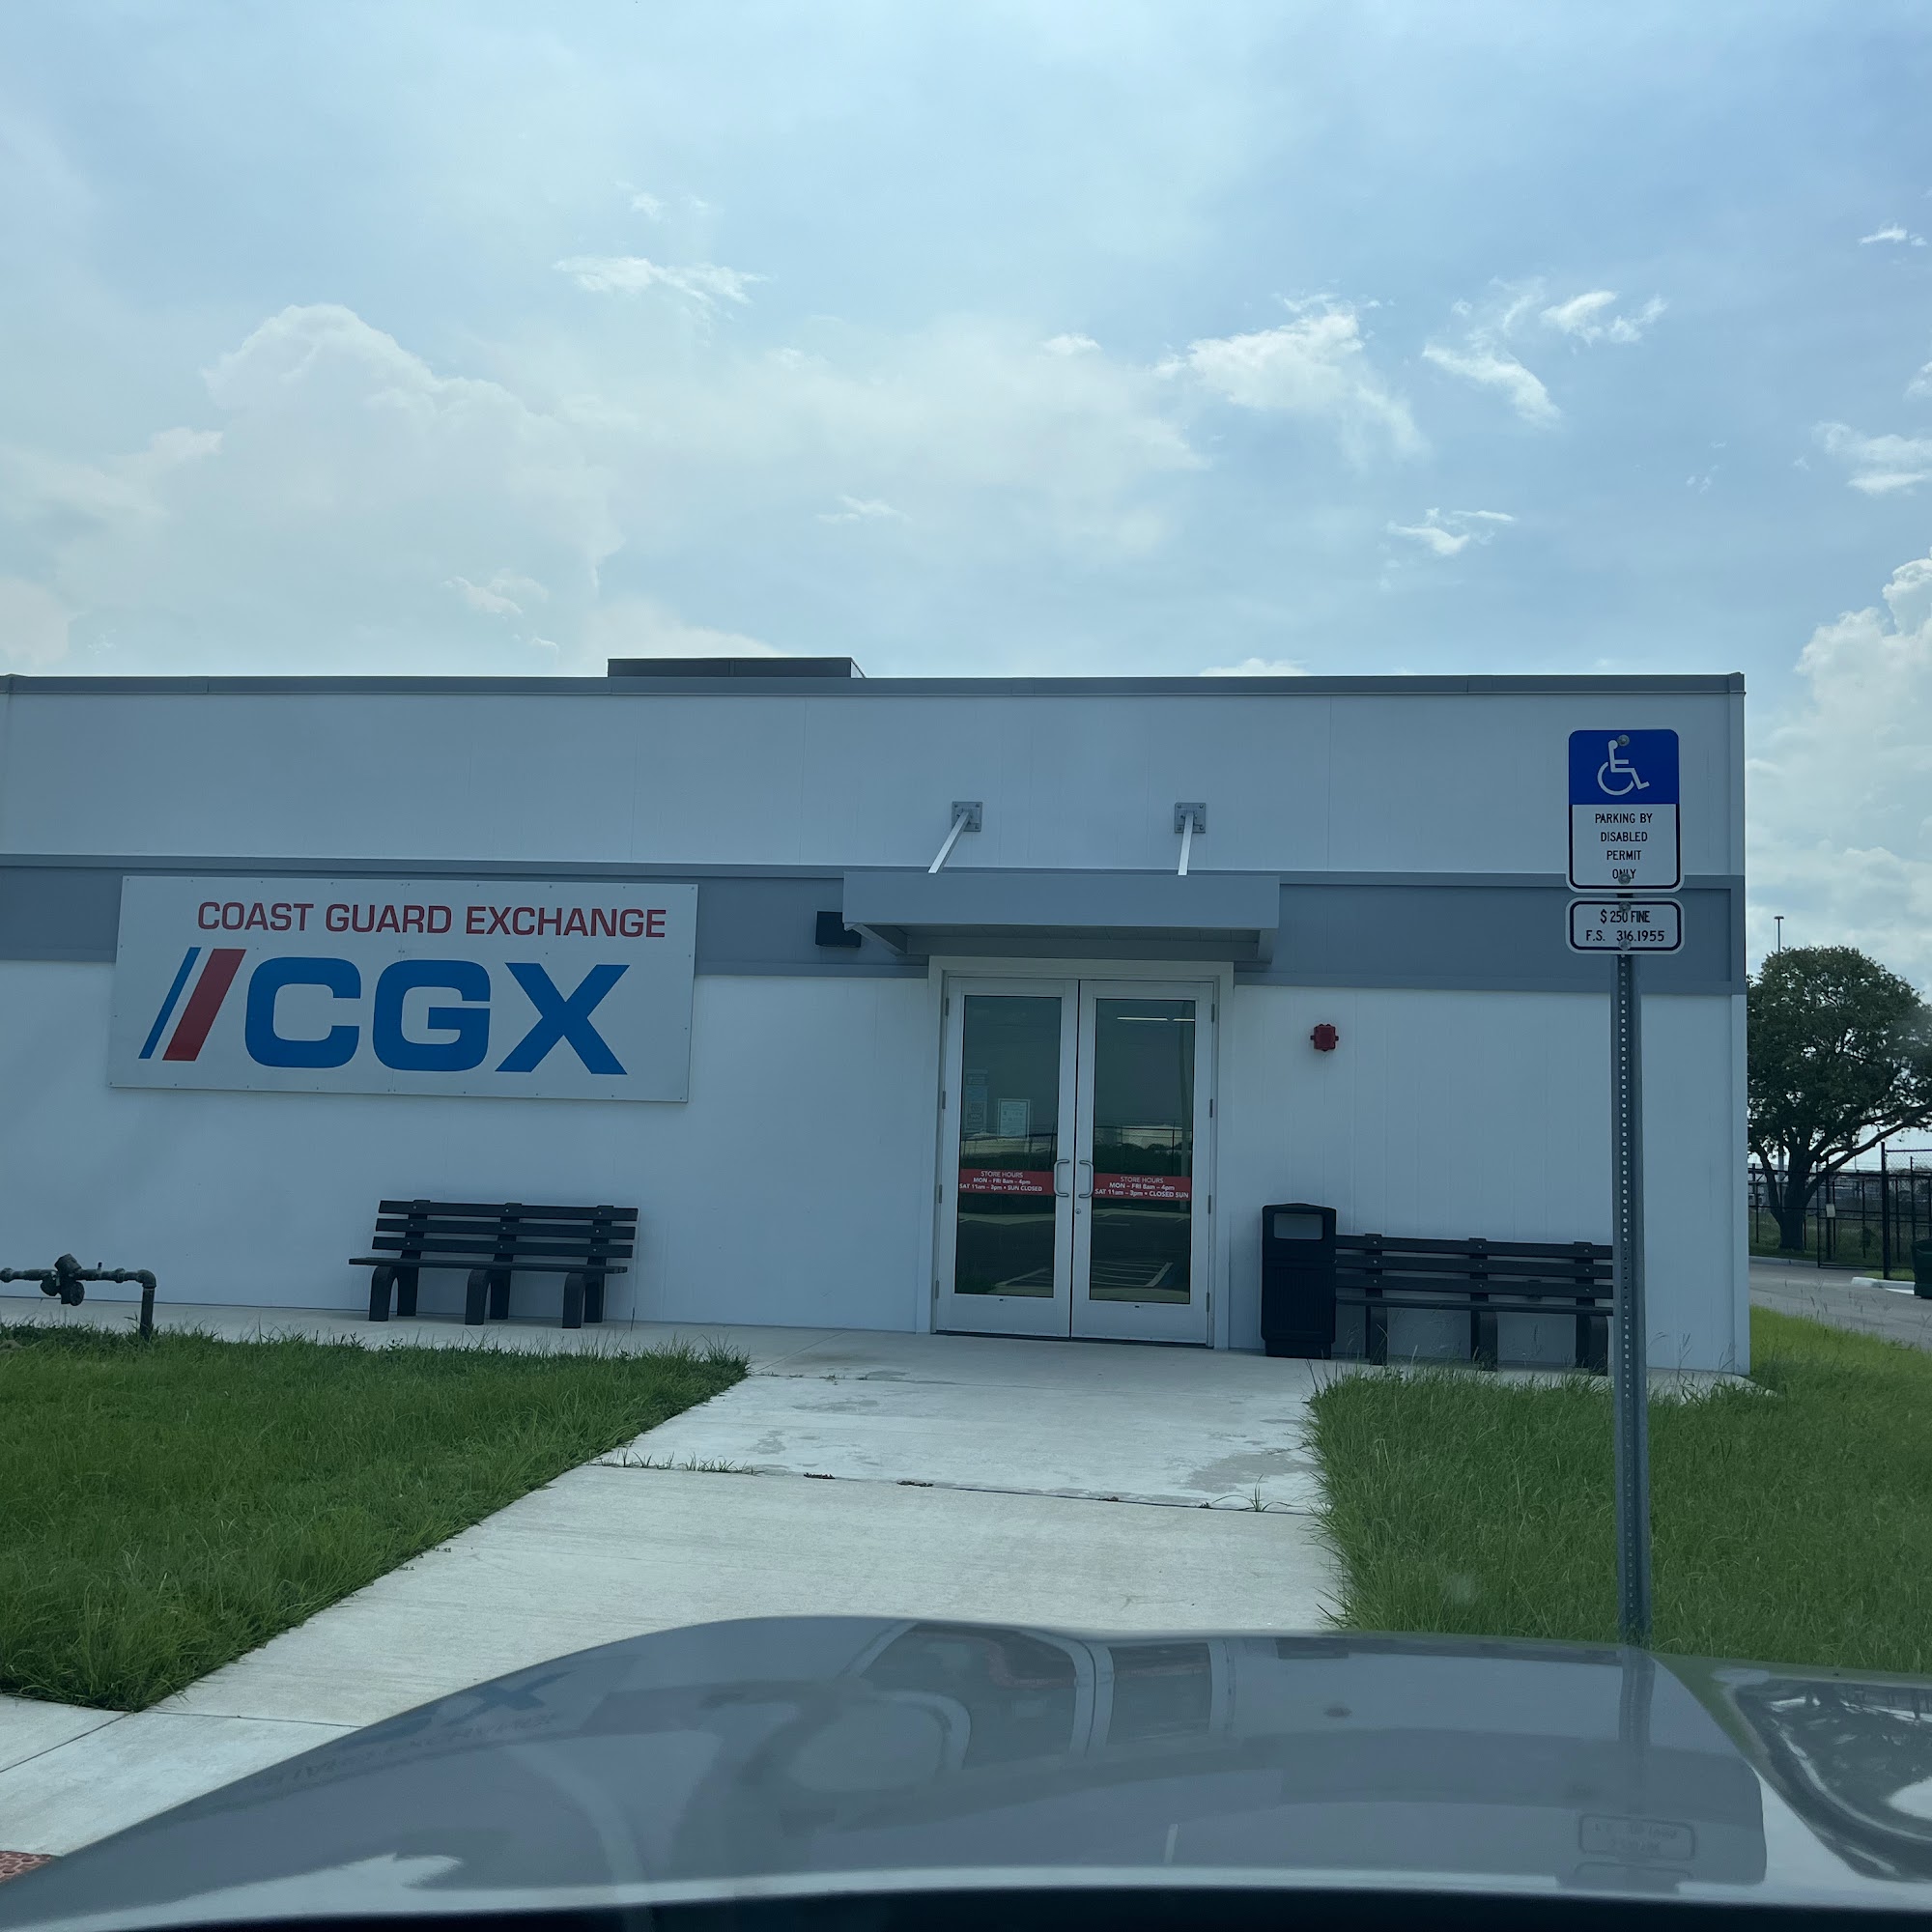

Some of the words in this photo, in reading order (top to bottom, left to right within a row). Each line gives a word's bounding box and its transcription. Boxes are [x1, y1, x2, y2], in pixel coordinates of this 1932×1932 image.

[1595, 813, 1635, 824] PARKING
[1640, 813, 1653, 824] BY
[1601, 832, 1648, 842] DISABLED
[1606, 850, 1642, 860] PERMIT
[197, 901, 313, 931] COAST
[325, 903, 453, 934] GUARD
[465, 906, 668, 938] EXCHANGE
[1631, 910, 1650, 923] FINE
[1586, 930, 1605, 941] F.S.
[1616, 930, 1665, 941] 316.1955
[244, 956, 631, 1075] CGX
